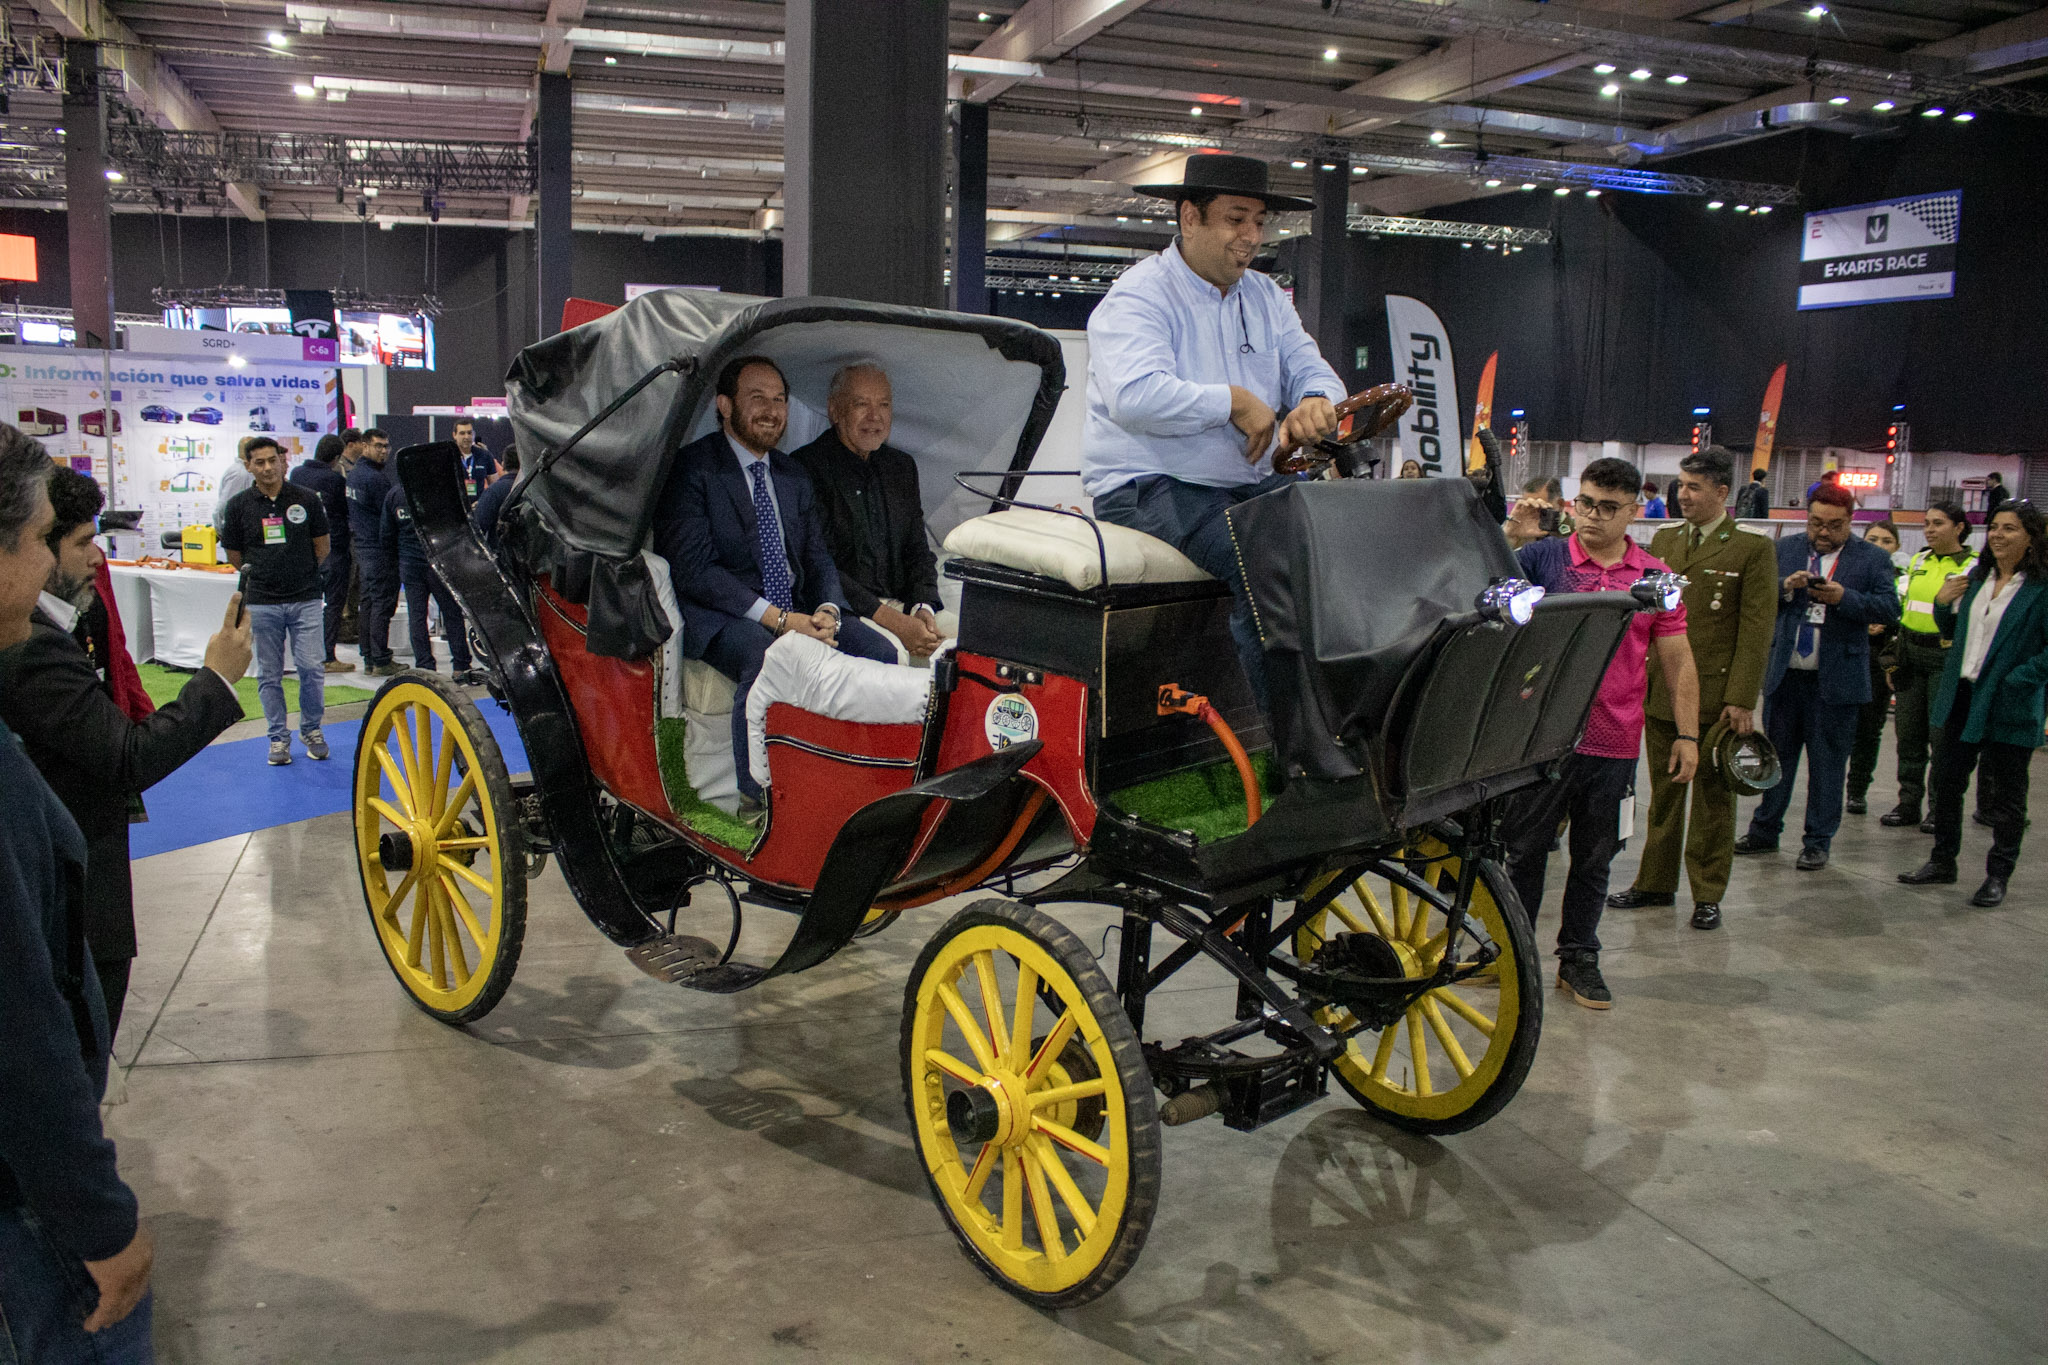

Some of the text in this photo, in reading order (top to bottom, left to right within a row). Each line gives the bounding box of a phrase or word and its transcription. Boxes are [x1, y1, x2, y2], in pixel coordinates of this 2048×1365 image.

[1824, 253, 1928, 278] E-KARTS RACE
[203, 338, 236, 348] SGRD+
[309, 345, 329, 355] C-6a
[170, 373, 208, 387] que
[215, 374, 266, 388] salva
[272, 375, 320, 389] vidas
